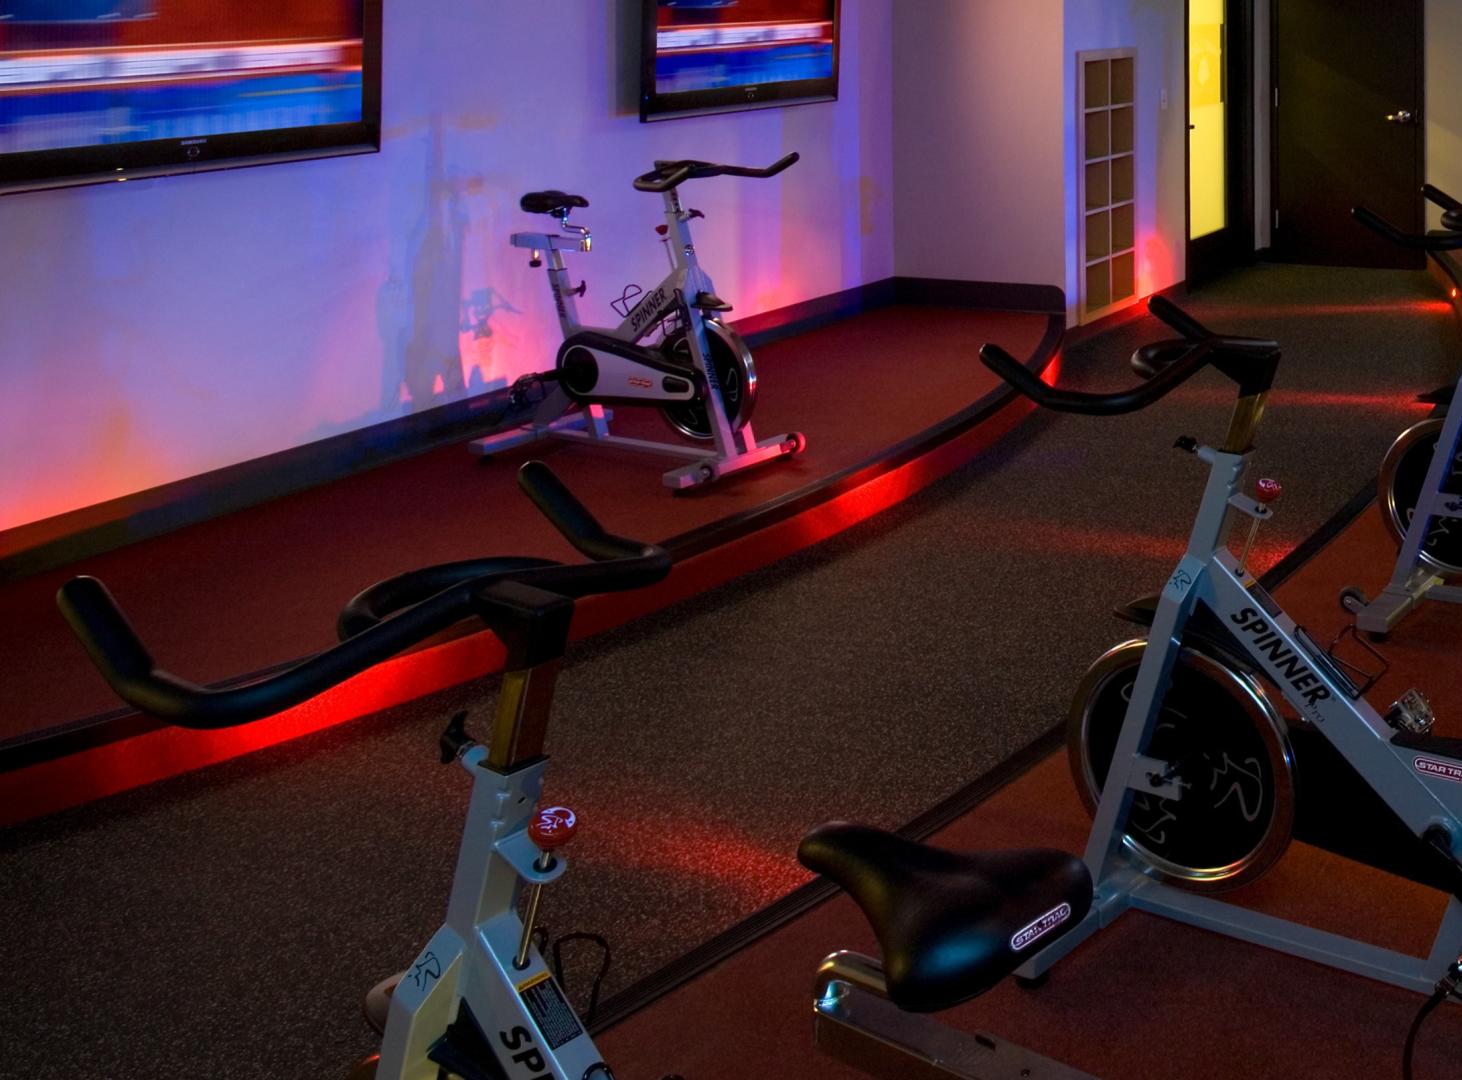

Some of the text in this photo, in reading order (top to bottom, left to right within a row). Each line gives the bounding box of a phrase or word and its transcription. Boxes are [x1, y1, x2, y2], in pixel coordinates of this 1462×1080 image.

[631, 287, 666, 333] SPINNER
[1230, 607, 1331, 704] SPINNER
[1418, 761, 1447, 775] STAR
